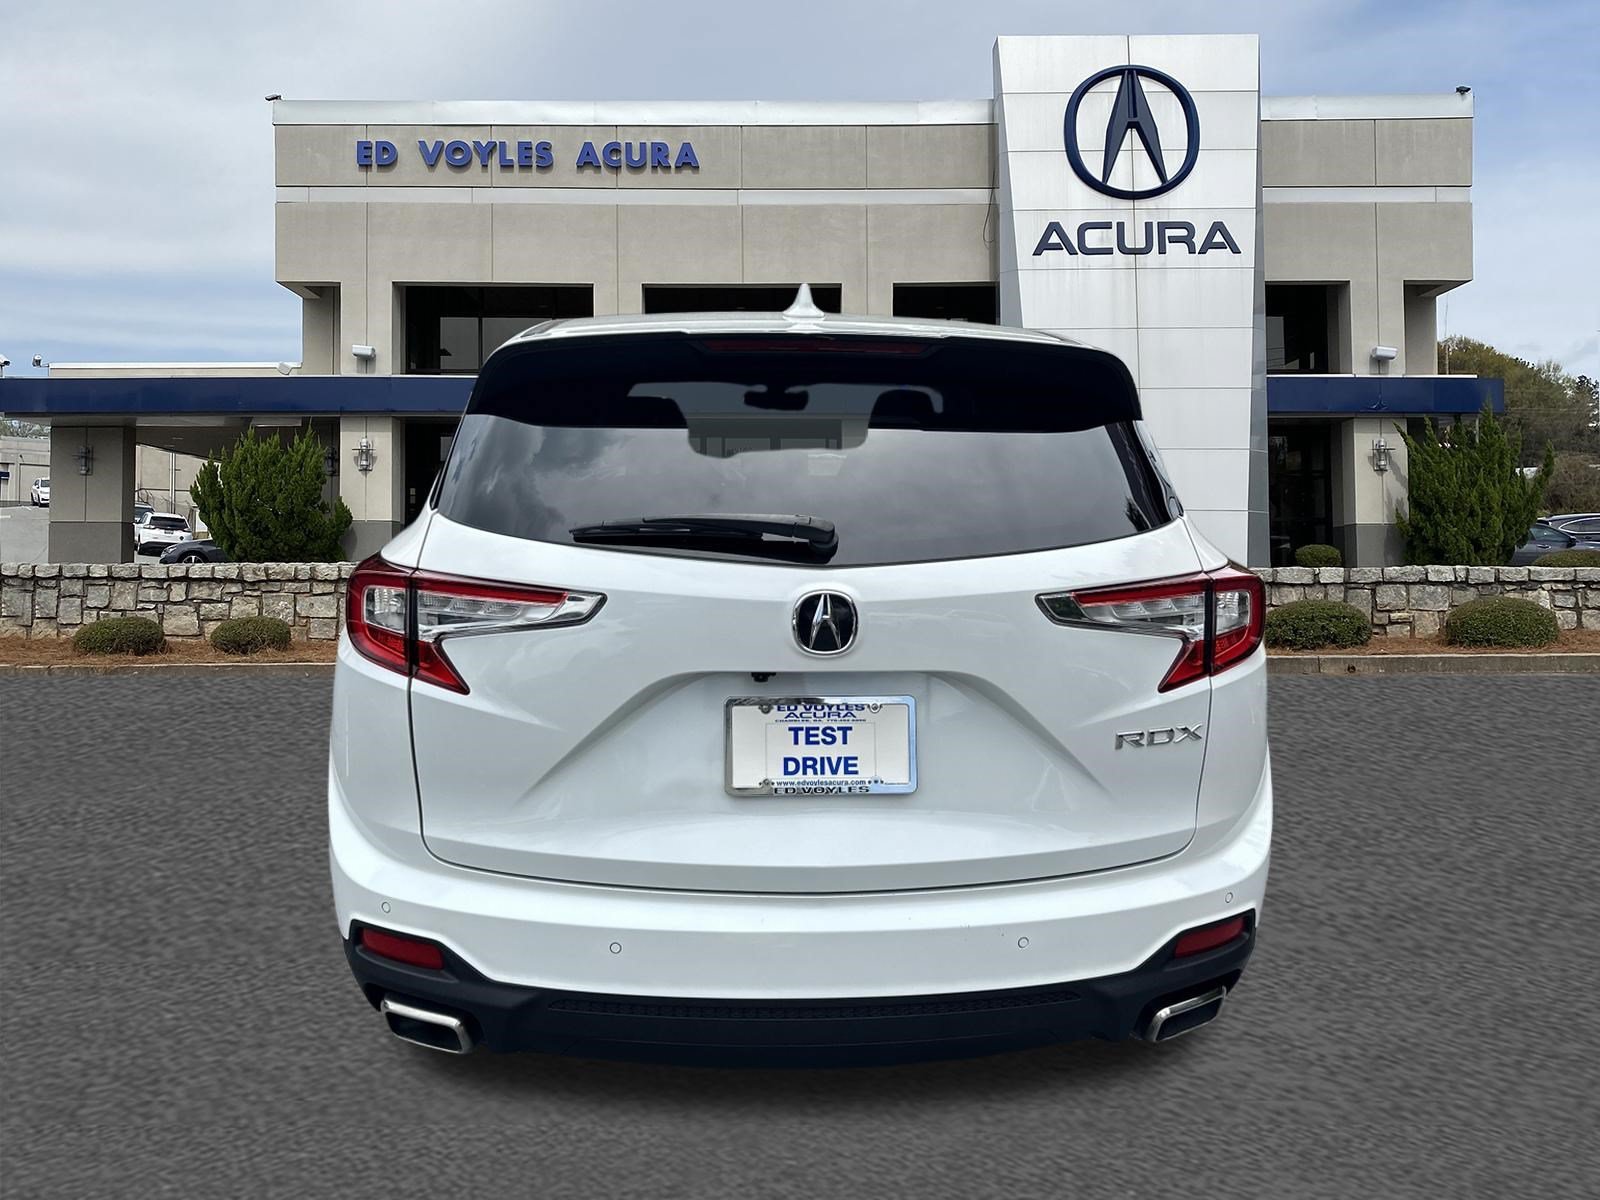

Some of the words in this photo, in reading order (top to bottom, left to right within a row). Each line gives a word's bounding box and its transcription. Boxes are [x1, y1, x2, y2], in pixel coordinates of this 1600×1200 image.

[356, 140, 398, 167] ED
[418, 139, 554, 167] VOYLES
[576, 141, 700, 168] ACURA
[1032, 221, 1242, 256] ACURA
[776, 703, 798, 712] ED
[803, 703, 866, 712] VOYLES
[784, 711, 857, 719] ACURA
[788, 726, 853, 746] TEST
[1114, 723, 1203, 751] RDX
[783, 756, 859, 776] DRIVE
[774, 786, 796, 794] ED
[801, 785, 870, 794] VOYLES
[776, 778, 867, 787] www.edvoylesacura.com
